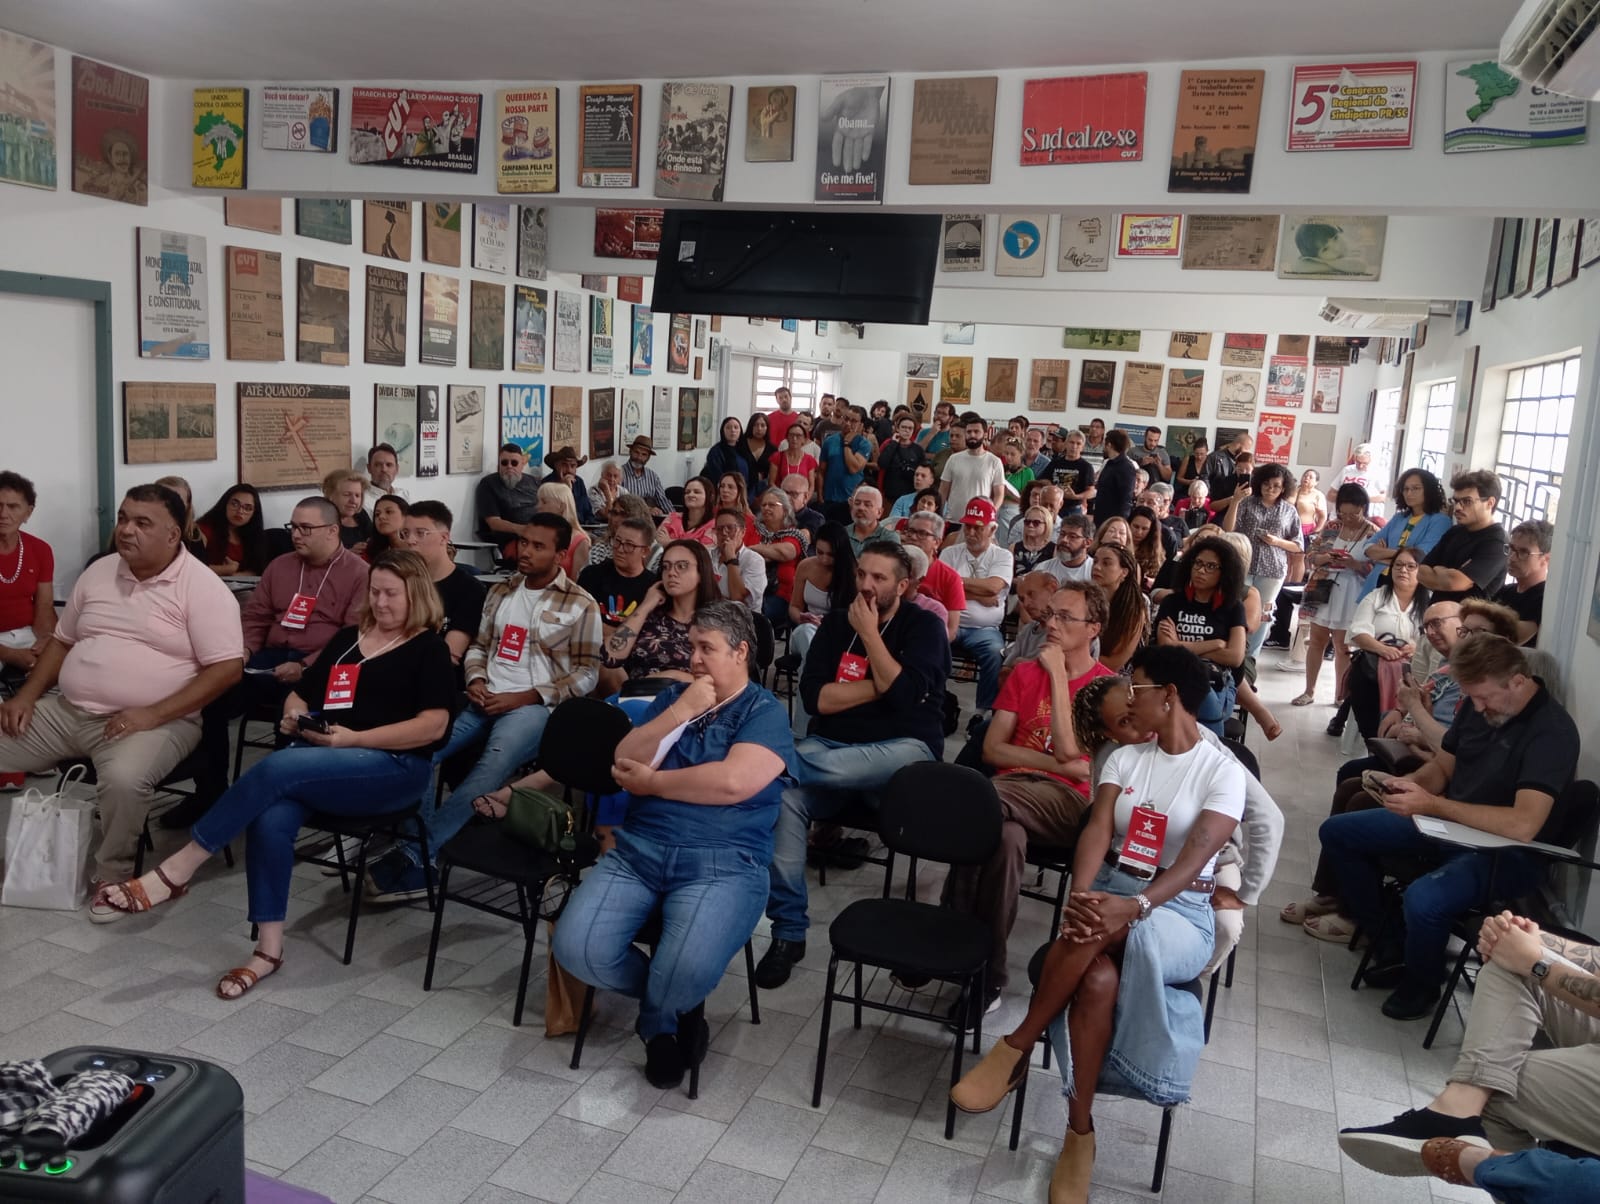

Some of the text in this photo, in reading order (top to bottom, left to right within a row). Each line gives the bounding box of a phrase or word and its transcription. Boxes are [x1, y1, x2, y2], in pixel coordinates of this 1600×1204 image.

[1340, 84, 1388, 96] Congresso
[264, 93, 310, 102] Você vai deixar?
[428, 95, 453, 103] MÍNIMO
[505, 92, 548, 102] QUEREMOS A
[1332, 96, 1372, 108] Regional
[1374, 95, 1387, 106] do
[505, 103, 549, 114] NOSSA PARTE
[1330, 107, 1408, 121] Sindipetro PR/SC
[384, 95, 412, 153] CUT
[838, 116, 875, 129] Obama...
[447, 152, 473, 161] BRASÍLIA
[667, 153, 703, 164] Onde está
[1120, 150, 1137, 158] CUT
[439, 160, 473, 170] NOVEMBRO
[501, 163, 530, 171] CAMPANHA
[672, 163, 702, 173] dinheiro
[821, 172, 874, 191] Give me five!
[237, 253, 256, 265] CUT
[153, 295, 202, 311] CONSTITUCIONAL
[1173, 333, 1198, 345] A TERRA
[245, 384, 311, 399] ATÉ QUANDO?
[503, 387, 542, 417] NICA
[503, 417, 544, 440] RAGUA
[1264, 426, 1289, 437] CUT
[967, 508, 984, 519] LULA
[1177, 609, 1206, 625] Lute
[1176, 623, 1214, 635] como
